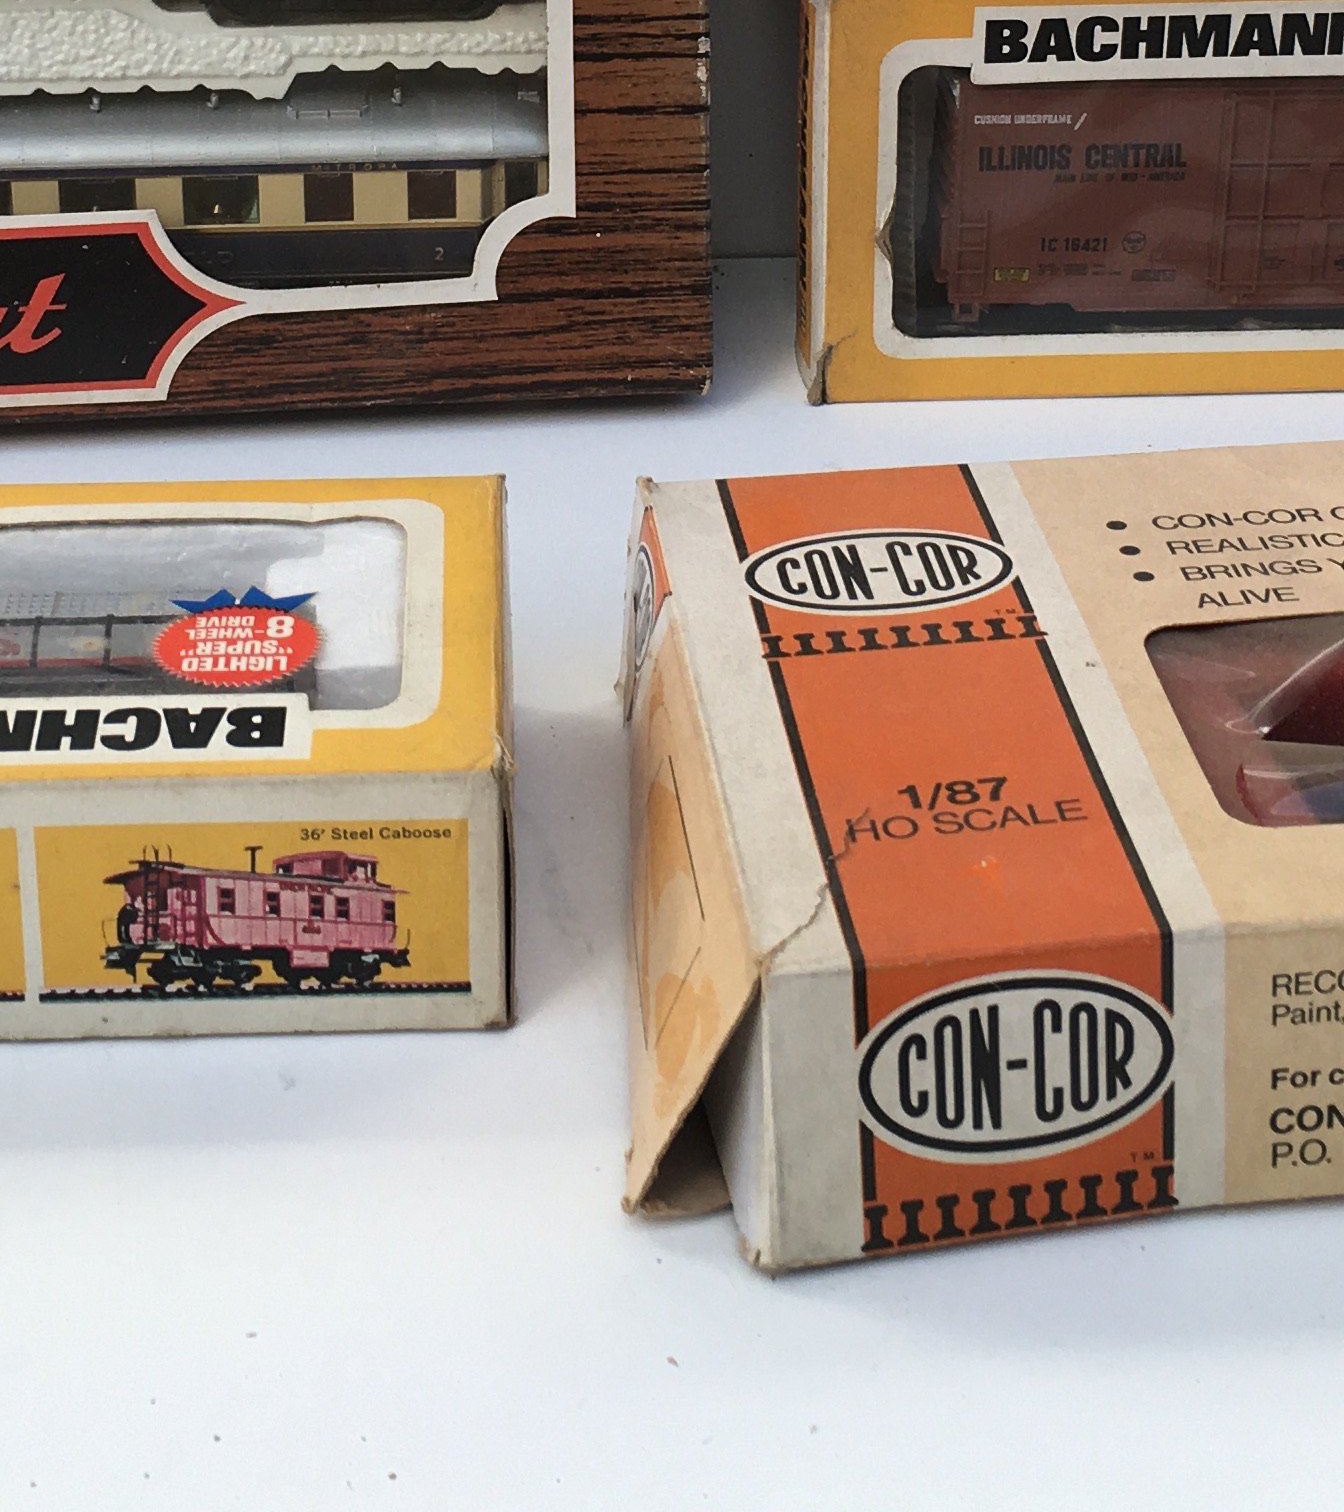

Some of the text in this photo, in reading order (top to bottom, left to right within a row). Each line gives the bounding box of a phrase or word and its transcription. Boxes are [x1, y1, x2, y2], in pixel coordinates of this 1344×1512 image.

[978, 142, 1187, 172] ILLINOIS CENTRAL
[433, 247, 445, 261] 2
[1151, 507, 1323, 532] CON-COR
[776, 538, 982, 601] CON-COR
[1179, 558, 1323, 583] BRINGS
[1197, 586, 1301, 609] ALIVE
[196, 616, 256, 627] DRIVE
[181, 656, 288, 672] LIGHTED
[896, 775, 1009, 812] 1/87
[330, 827, 374, 841] Steel
[379, 826, 452, 839] Caboose
[844, 797, 1089, 846] HO SCALE
[897, 998, 1137, 1132] CON-COR
[1271, 1066, 1322, 1091] For
[1270, 1137, 1334, 1169] P.O.
